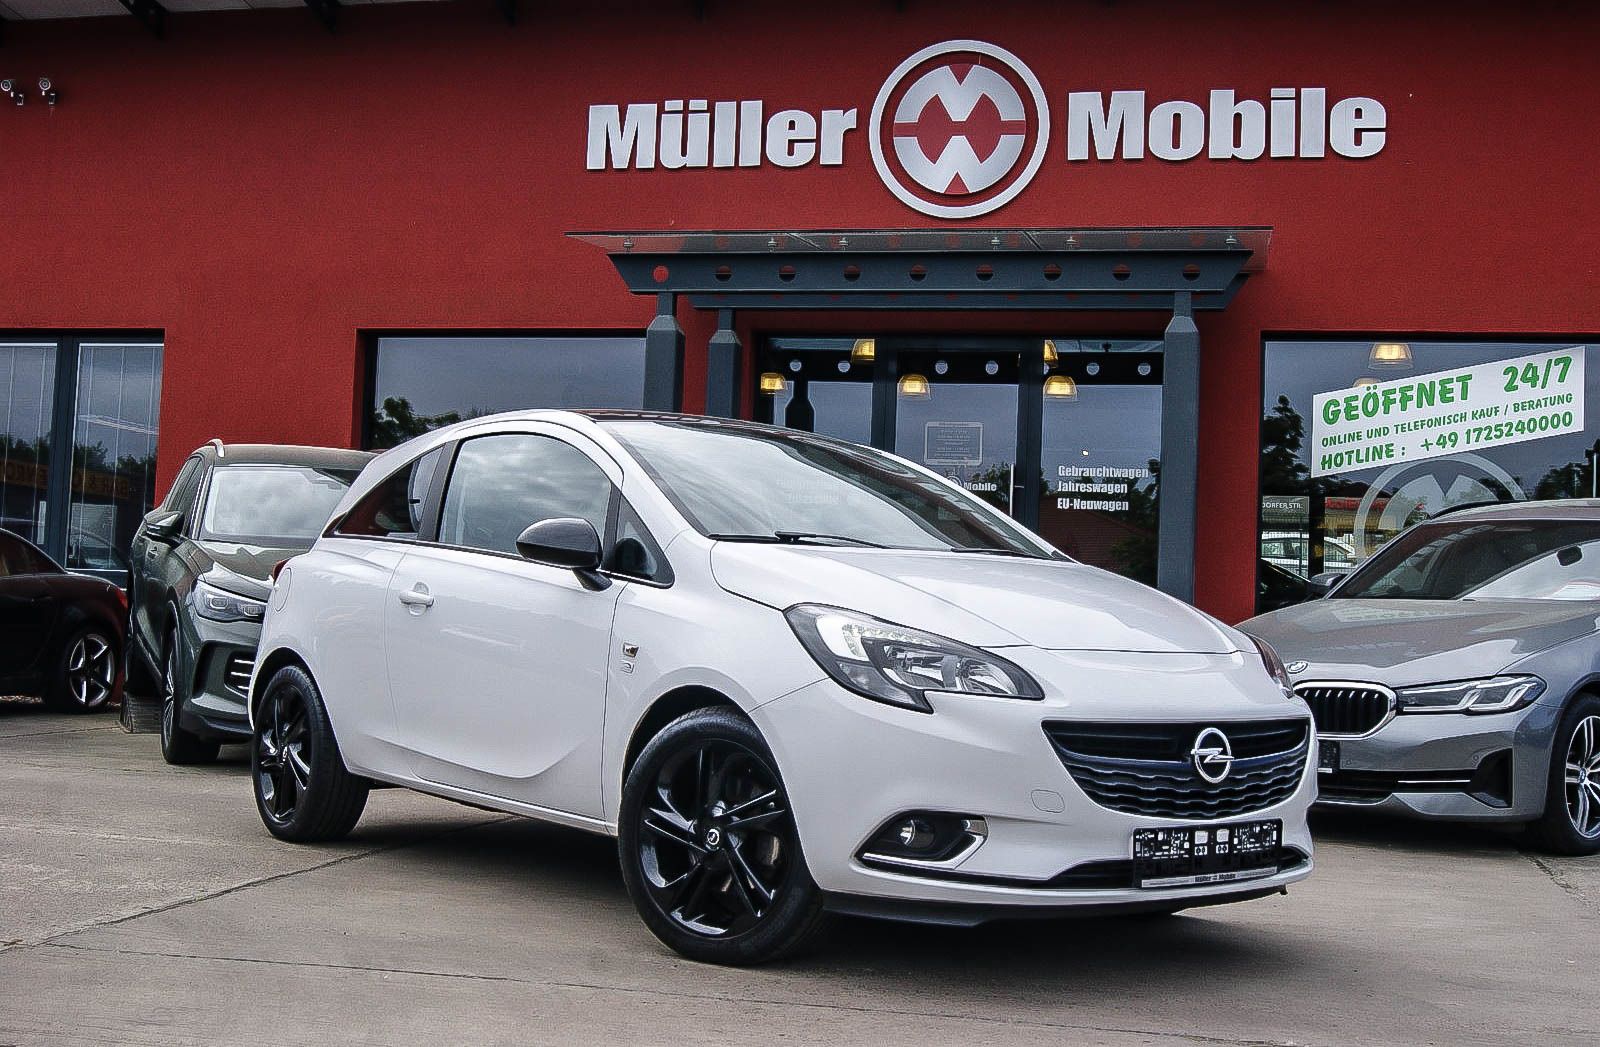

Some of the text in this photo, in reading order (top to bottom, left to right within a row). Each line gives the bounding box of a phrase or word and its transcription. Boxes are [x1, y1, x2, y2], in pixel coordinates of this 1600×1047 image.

[586, 99, 857, 170] Müller
[1067, 86, 1387, 162] Mobile
[1322, 356, 1573, 425] GEÖFFNET 24/7
[1320, 443, 1395, 471] HOTLINE
[1420, 431, 1459, 452] +49
[1465, 411, 1573, 445] 1725240000
[1321, 393, 1573, 448] ONLINE UND TELEFONISCH KAUF / BERATUNG
[963, 482, 997, 492] Mobile
[1057, 480, 1128, 495] Jahreswagen
[1058, 465, 1149, 479] Gebrauchtwagen
[1057, 497, 1129, 512] EU-Neuwagen
